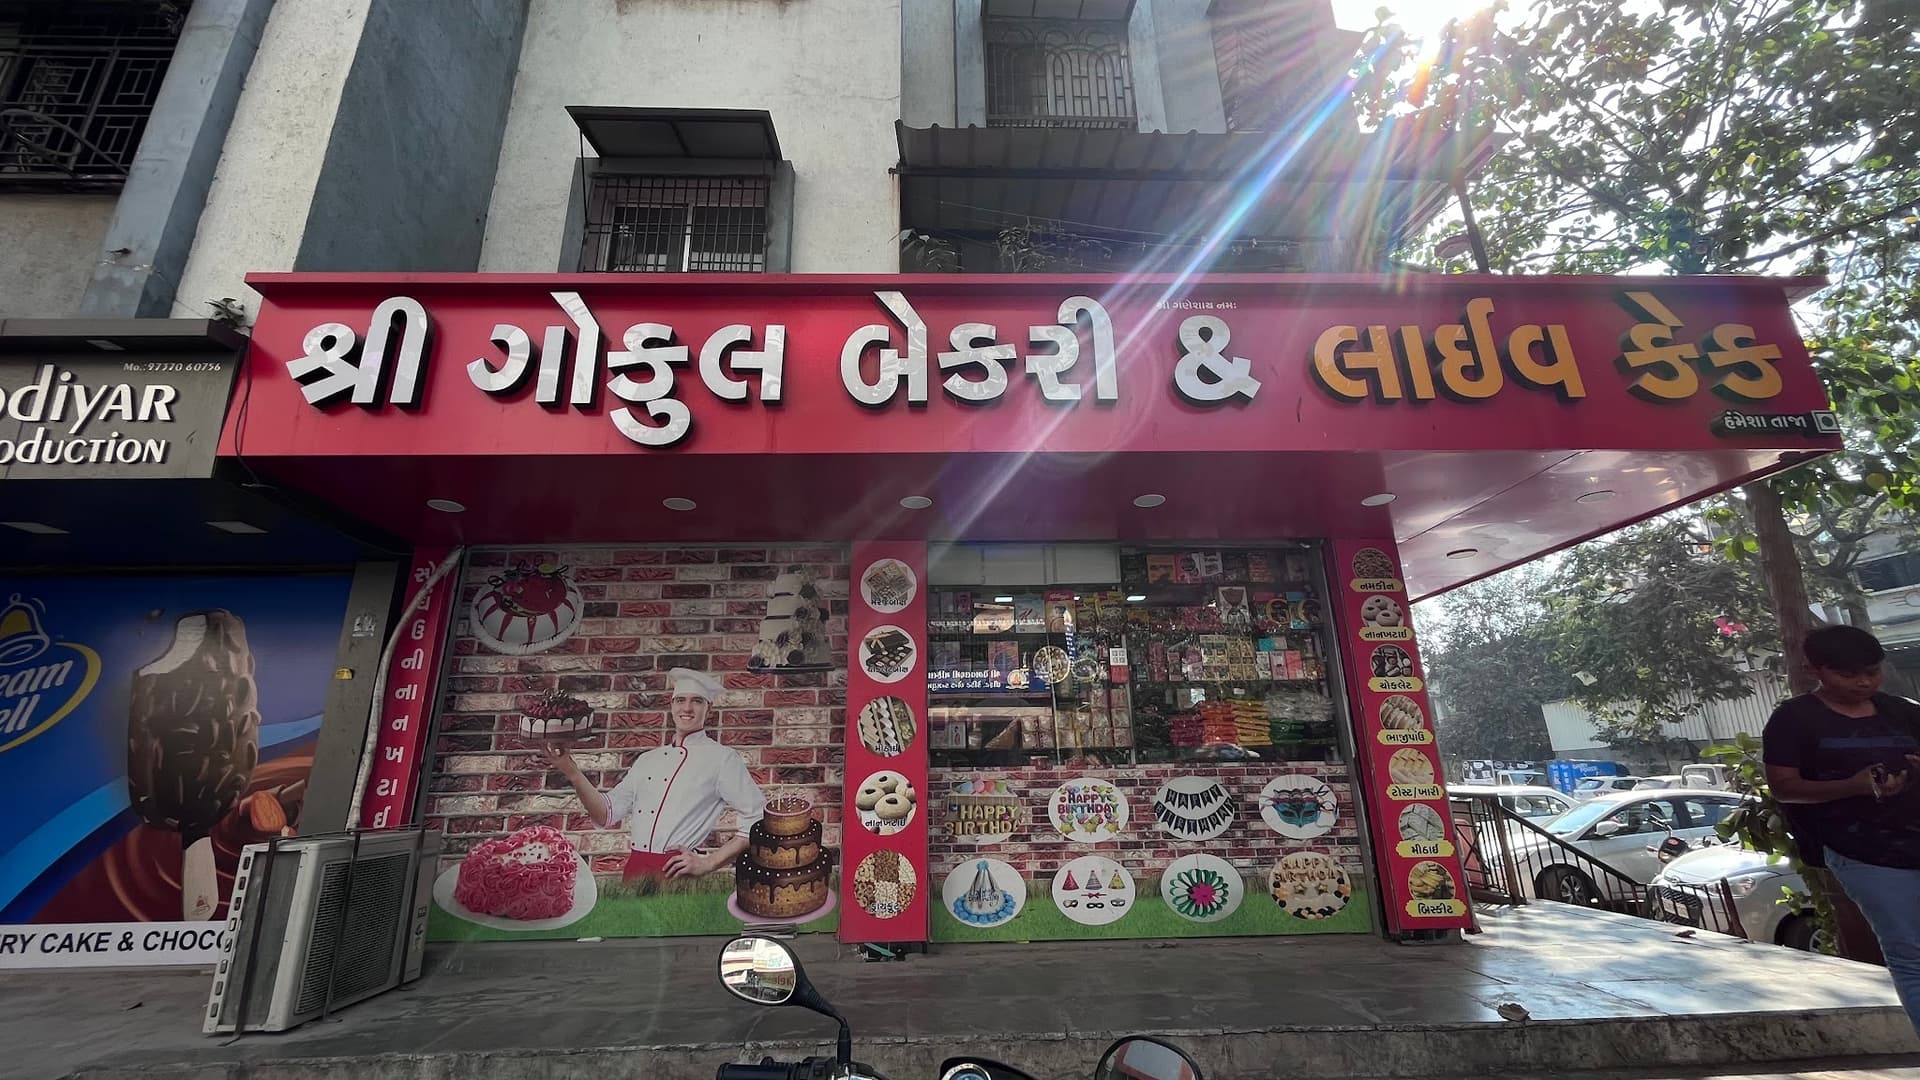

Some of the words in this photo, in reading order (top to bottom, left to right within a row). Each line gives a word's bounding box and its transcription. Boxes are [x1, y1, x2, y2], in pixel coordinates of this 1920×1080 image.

[185, 362, 221, 372] 60756
[285, 296, 430, 405] શ્રી
[466, 291, 788, 447] ગોકુલ
[840, 291, 1119, 405] બેકરી
[1174, 314, 1262, 401] &
[1311, 297, 1587, 401] લાઈવ
[1619, 291, 1784, 399] કેક
[0, 363, 177, 434] diyAR
[1379, 680, 1413, 690] ચોકલેટ
[1068, 792, 1109, 804] HAPPY
[1166, 785, 1221, 807] HAPPY
[960, 805, 1018, 820] HAPPY
[1057, 802, 1120, 815] BIRTHDAY
[1155, 799, 1234, 832] BIRTHDAY
[40, 931, 113, 954] CAKE
[117, 931, 134, 952] &
